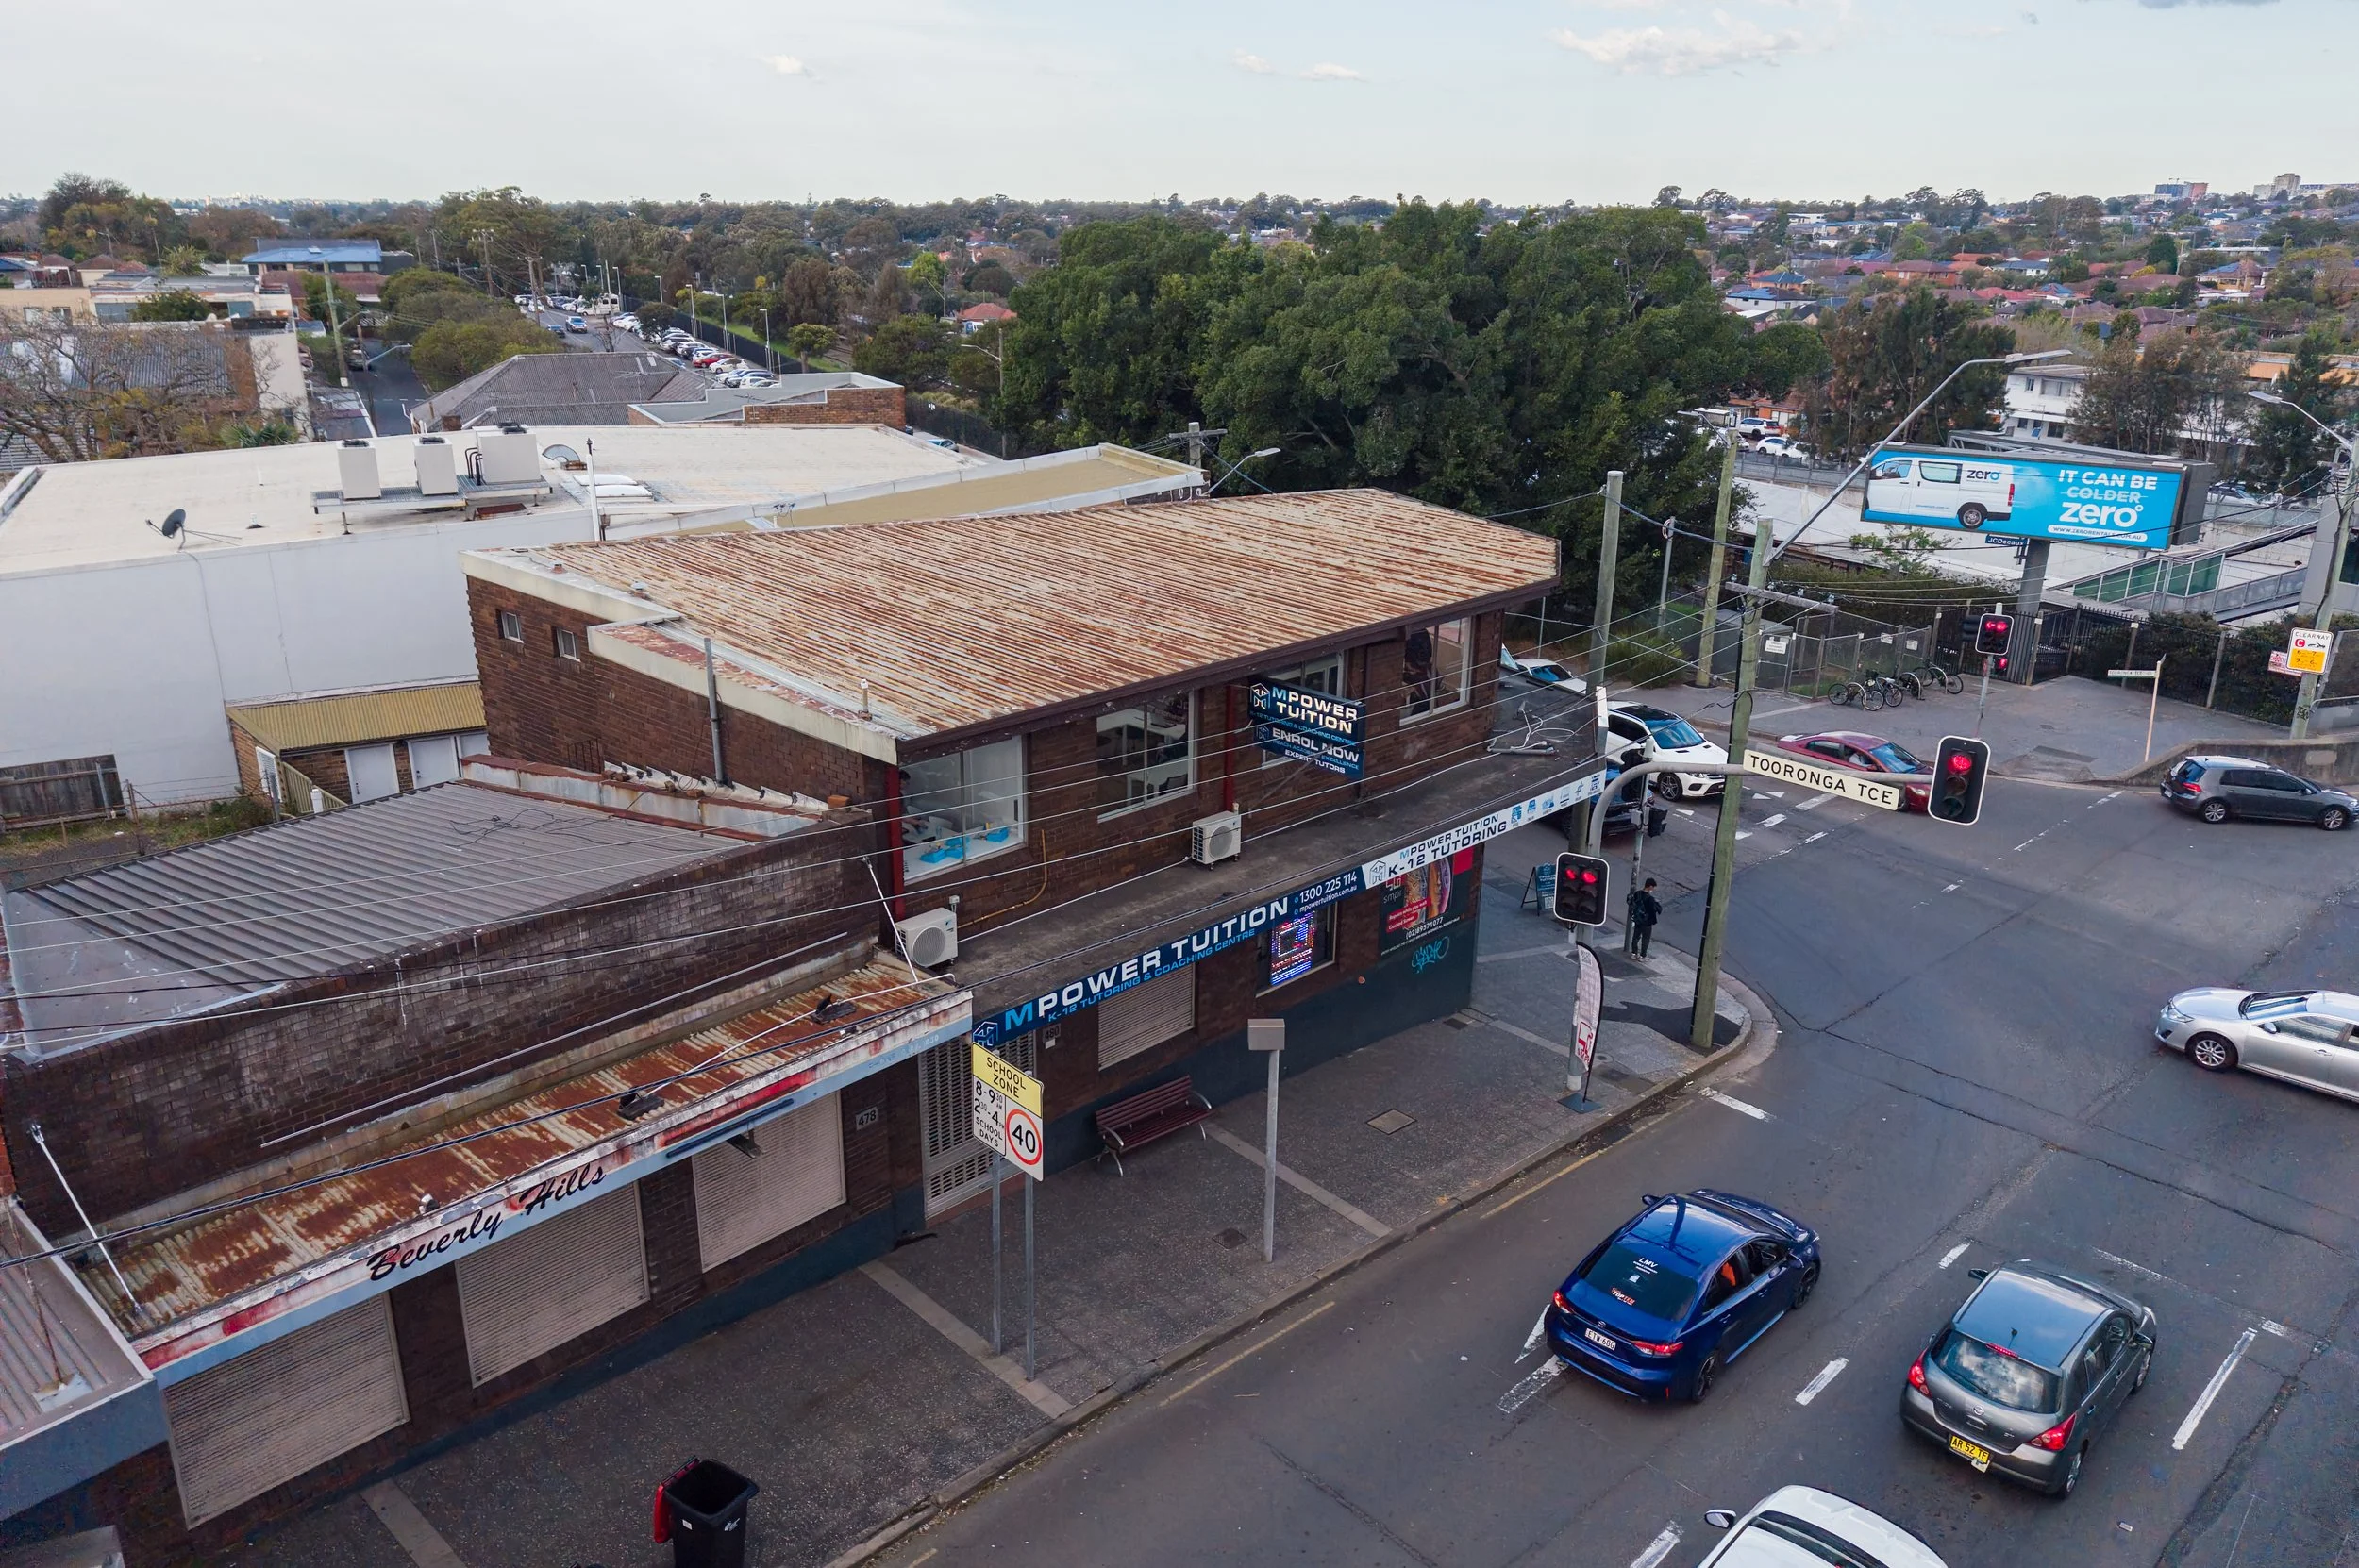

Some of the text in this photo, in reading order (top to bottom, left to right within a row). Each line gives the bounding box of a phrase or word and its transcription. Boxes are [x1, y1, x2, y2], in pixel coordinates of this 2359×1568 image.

[1966, 469, 2000, 481] zero
[2058, 469, 2158, 490] IT CAN BE
[2066, 486, 2142, 503] COLDER
[1988, 537, 2025, 547] JCDecaux
[2295, 632, 2330, 641] CLEARWAY
[1272, 686, 1358, 721] MPOWER
[1276, 701, 1352, 734] TUITION
[1272, 726, 1360, 763] ENROL NOW
[1314, 759, 1346, 774] TUTORS
[1750, 755, 1893, 805] TOORONGA TCE
[1388, 821, 1508, 877] K-12 TUTORING
[1399, 814, 1499, 859] MPOWER TUITION
[1299, 870, 1357, 904] 1300 225 114
[1299, 884, 1358, 913] mpowertuition.com.au
[1005, 949, 1161, 1031] MPOWER
[1171, 896, 1289, 959] TUITION
[1047, 928, 1255, 1022] K-12 TUTORING & COACHING CENTRE
[986, 1057, 1026, 1090] SCHOOL
[993, 1074, 1019, 1098] ZONE
[857, 1109, 877, 1126] 478
[976, 1116, 1003, 1141] SCHOOL
[979, 1128, 998, 1147] DAYS
[1012, 1124, 1036, 1154] 40
[366, 1162, 607, 1281] Beverly Hills
[1638, 1257, 1659, 1268] LMV
[1951, 1437, 1989, 1460] AR 52 TF
